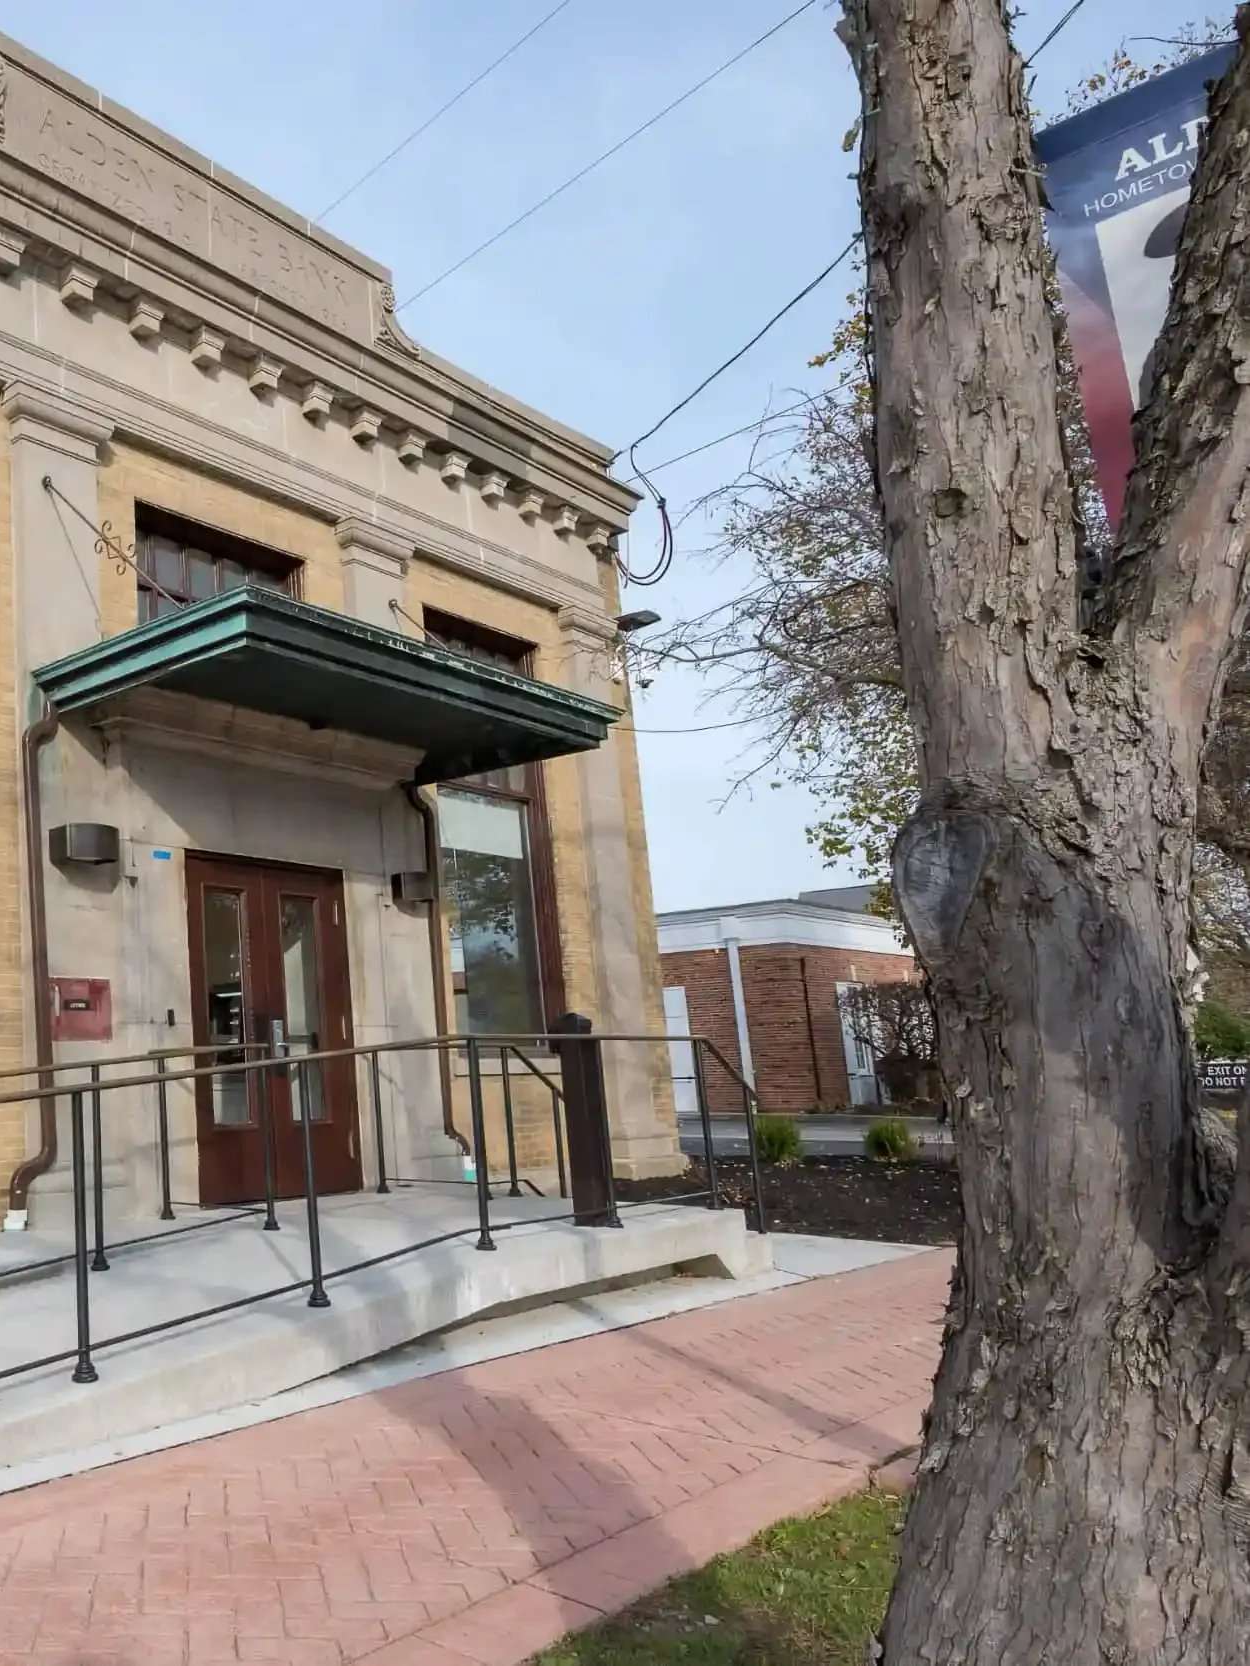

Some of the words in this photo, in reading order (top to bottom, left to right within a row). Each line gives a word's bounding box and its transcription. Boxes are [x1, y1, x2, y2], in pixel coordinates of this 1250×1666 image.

[38, 108, 156, 193] ALDEN
[172, 183, 263, 257] STATE
[278, 241, 349, 308] BANK
[1207, 1066, 1230, 1075] EXIT
[1215, 1077, 1238, 1086] NOT
